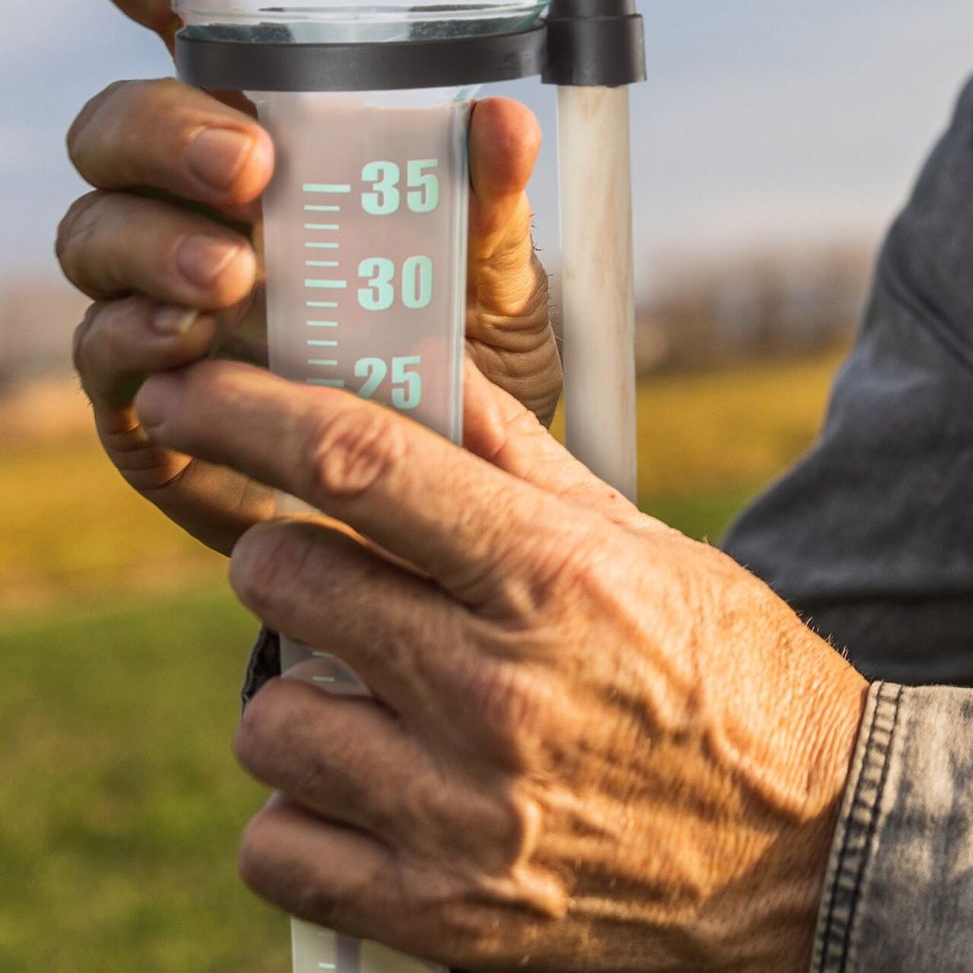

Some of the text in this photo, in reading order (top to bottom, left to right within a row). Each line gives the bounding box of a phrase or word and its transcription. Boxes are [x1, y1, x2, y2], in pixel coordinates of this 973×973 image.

[361, 159, 439, 215] 35
[357, 256, 433, 311] 30
[354, 356, 422, 409] 25
